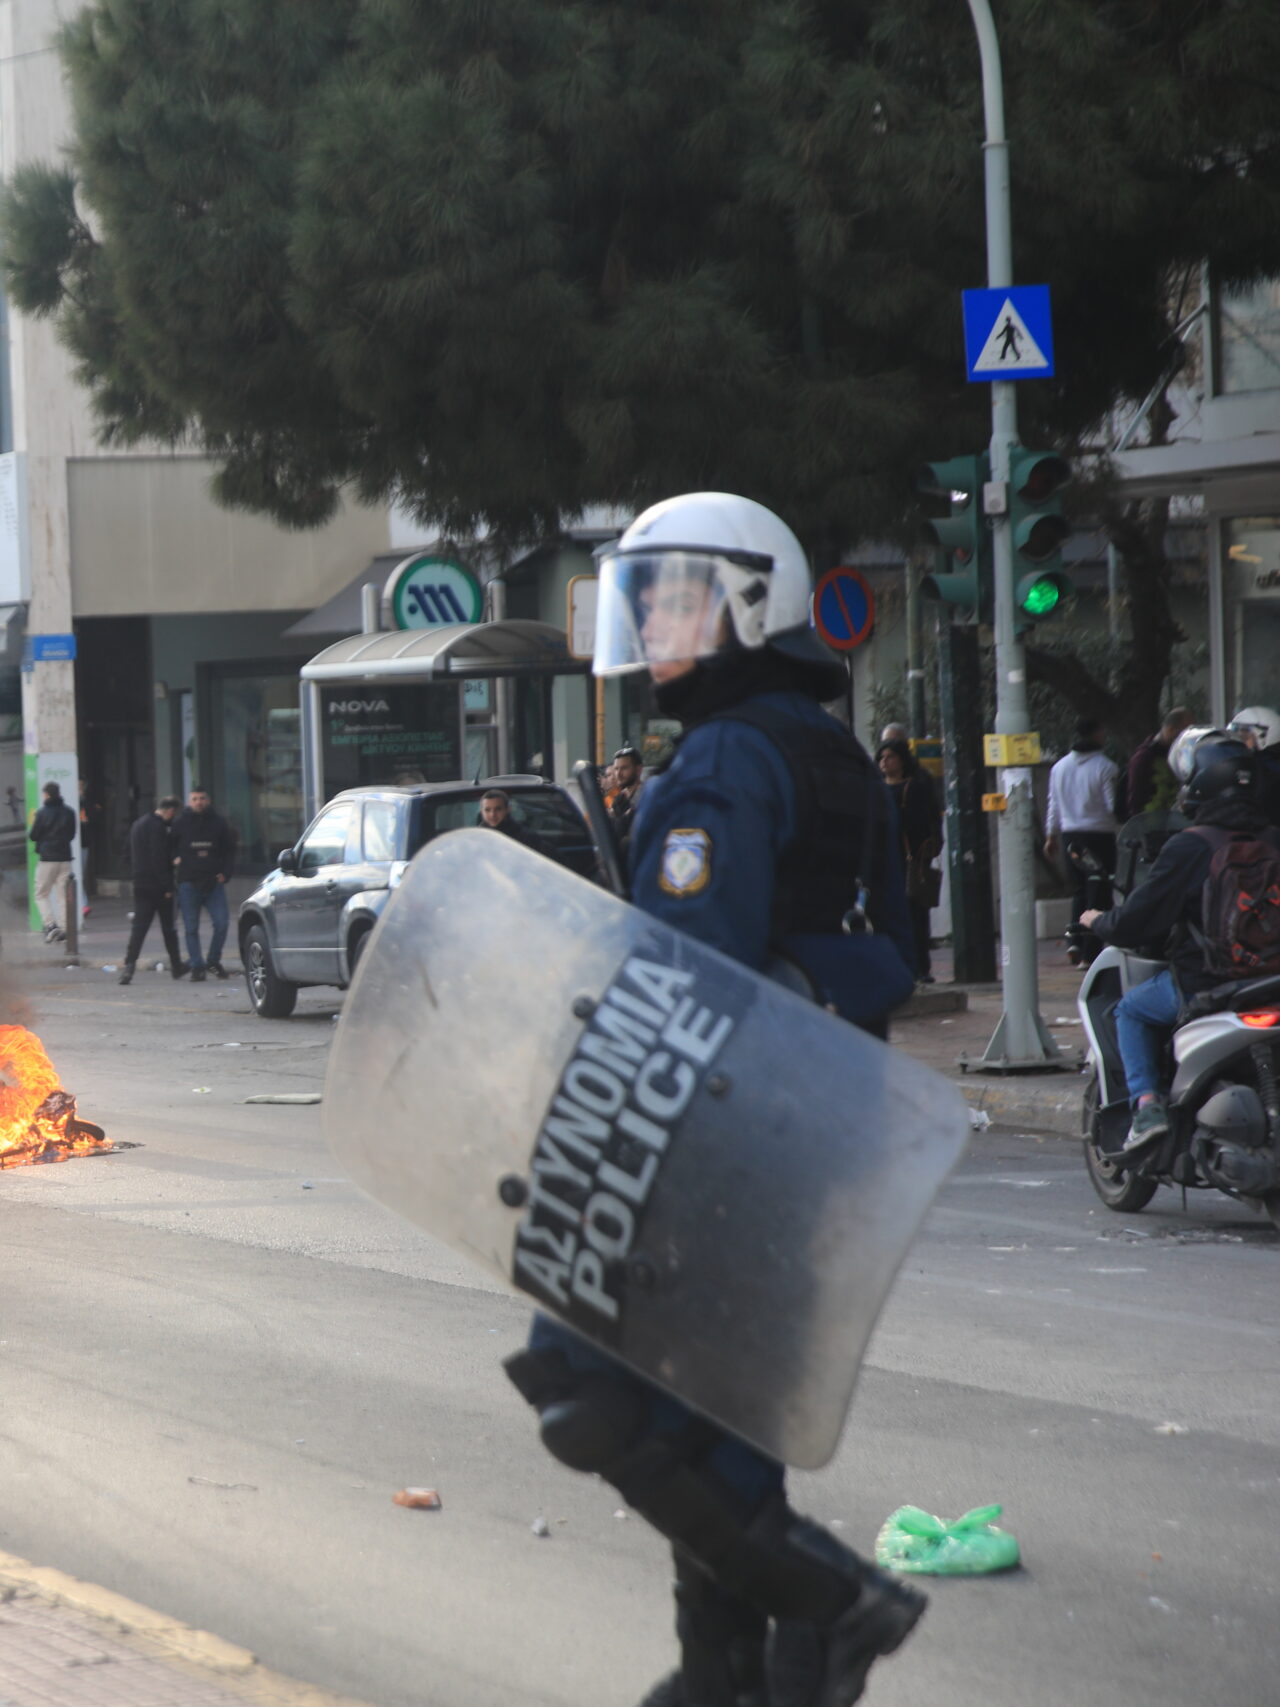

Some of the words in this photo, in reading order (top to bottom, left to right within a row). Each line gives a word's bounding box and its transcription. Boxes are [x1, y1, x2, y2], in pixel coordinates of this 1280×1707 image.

[328, 700, 390, 713] NOVA
[515, 956, 696, 1304] ΑΣΤΥΝΟΜΙΑ
[571, 995, 734, 1320] POLICE
